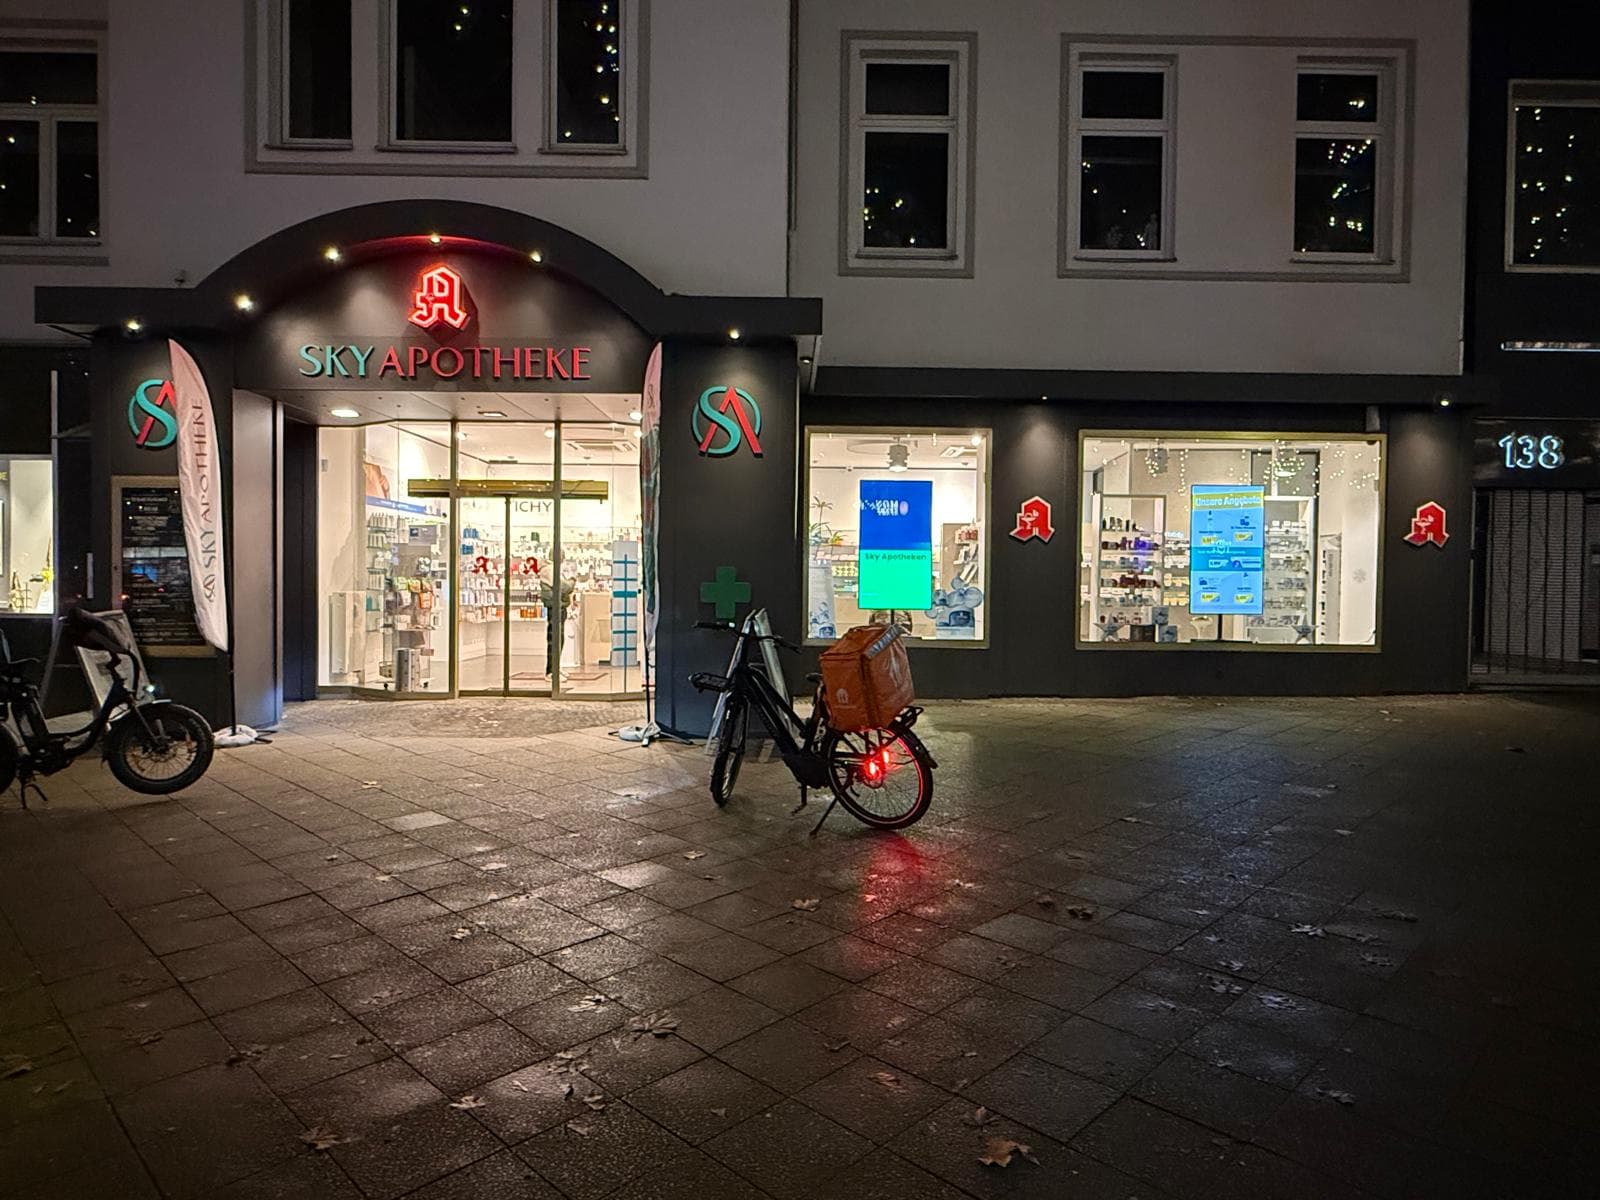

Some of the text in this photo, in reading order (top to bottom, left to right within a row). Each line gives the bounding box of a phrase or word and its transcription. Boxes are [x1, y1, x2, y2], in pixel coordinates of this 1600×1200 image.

[298, 344, 592, 379] SKY APOTHEKE
[1498, 433, 1564, 470] 138
[511, 500, 552, 513] ICHY
[201, 527, 217, 569] SKY
